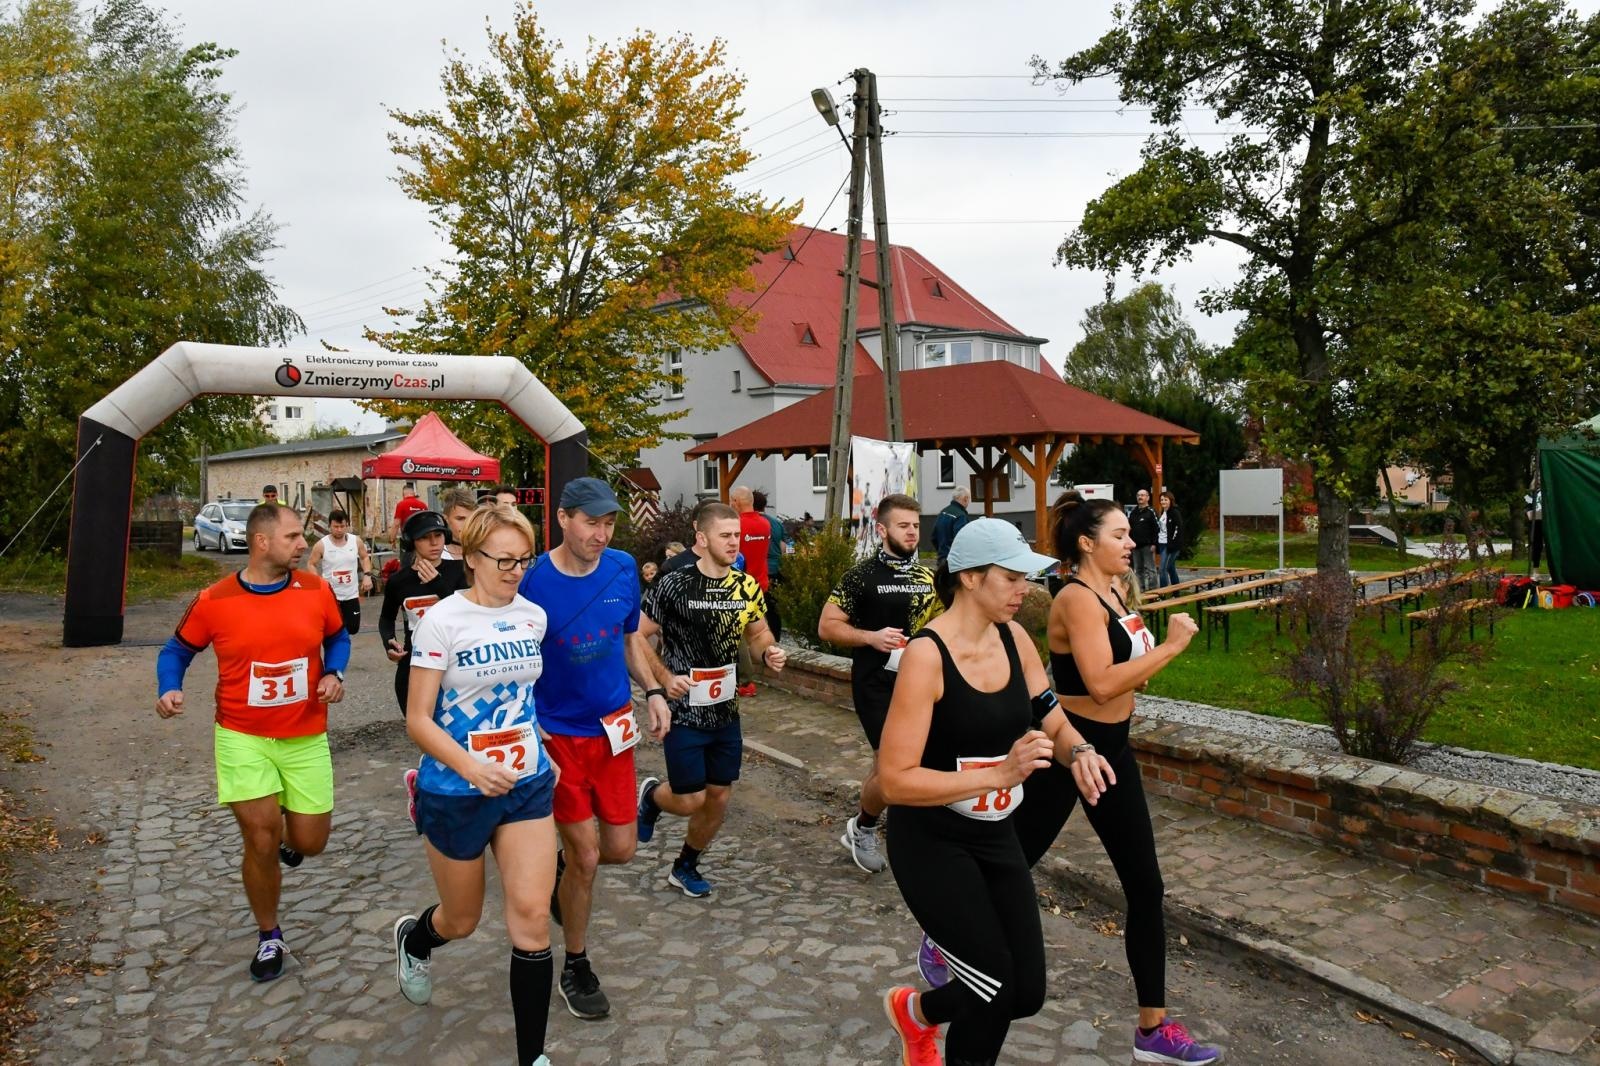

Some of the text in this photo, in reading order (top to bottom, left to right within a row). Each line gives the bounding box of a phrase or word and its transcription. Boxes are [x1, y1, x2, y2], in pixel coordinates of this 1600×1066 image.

[306, 355, 374, 367] Elektroniczny
[376, 359, 409, 367] pomiar
[304, 370, 445, 391] ZmierzymyCzas.pl
[337, 575, 352, 584] 13
[876, 584, 931, 594] RUNMAGEDDON
[688, 599, 746, 610] RUNMAGEDDON
[476, 664, 525, 678] EKO-OKNA
[261, 677, 296, 701] 31
[709, 680, 722, 699] 6
[971, 786, 1012, 812] 18
